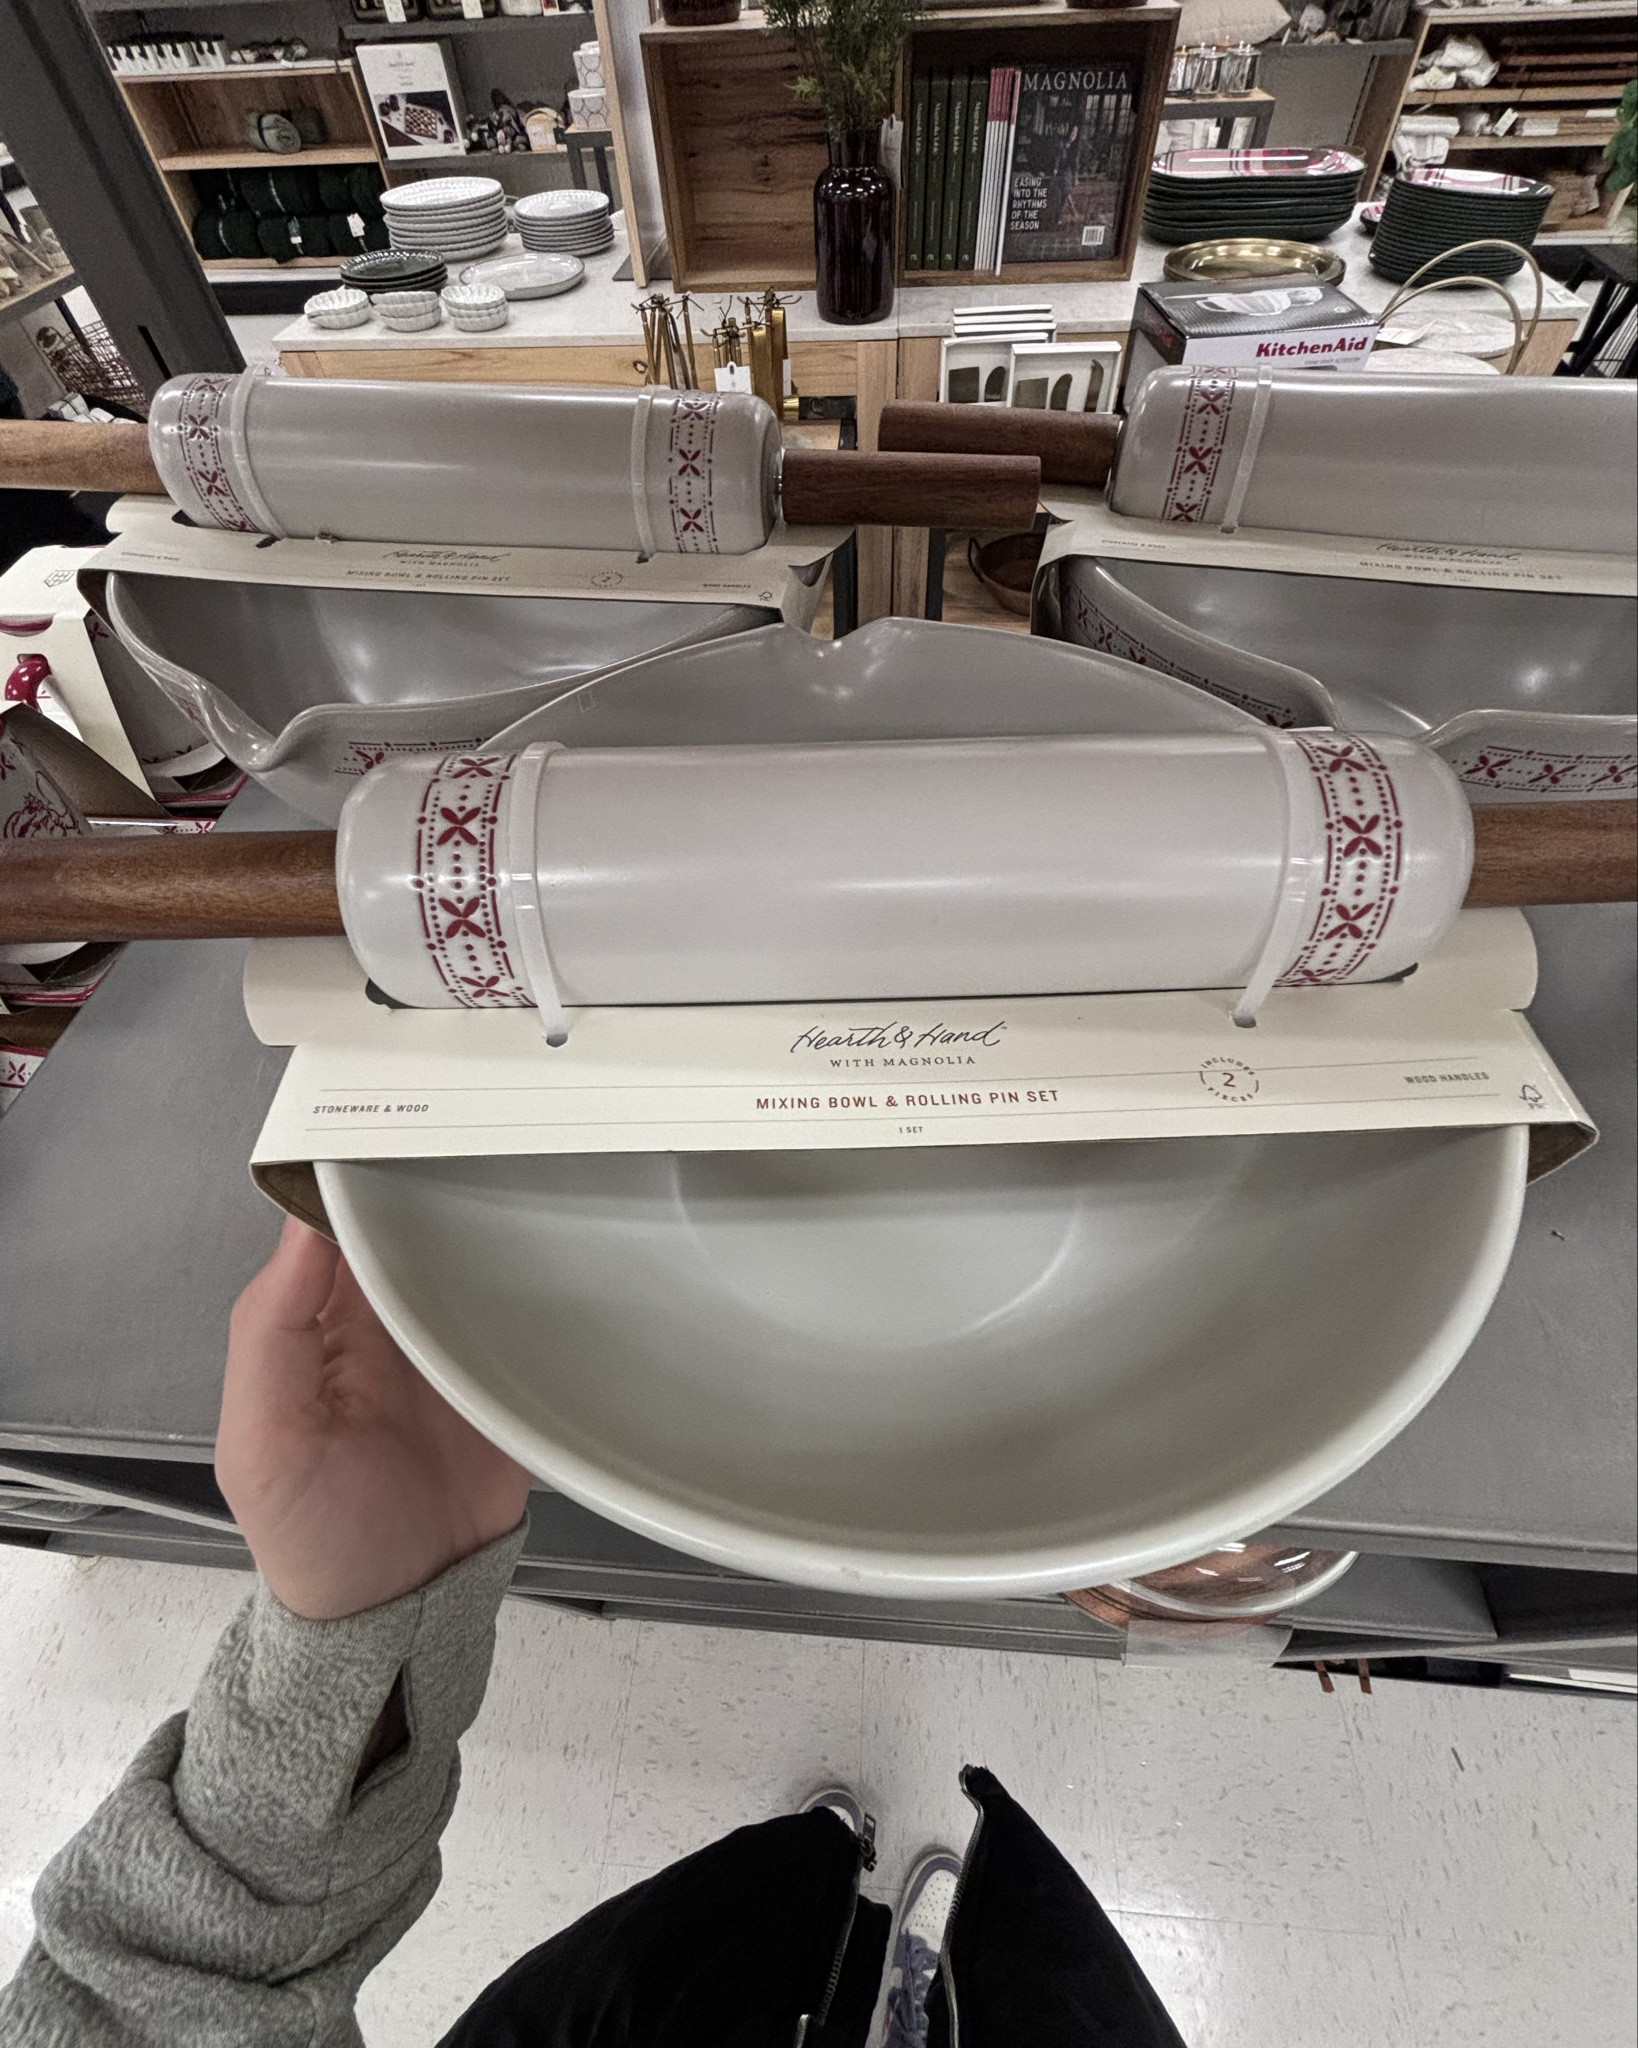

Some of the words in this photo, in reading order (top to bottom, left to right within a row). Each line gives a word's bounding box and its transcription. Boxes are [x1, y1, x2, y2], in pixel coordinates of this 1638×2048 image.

[1023, 71, 1127, 91] MAGNOLIA
[1014, 177, 1042, 187] EASING
[1013, 188, 1031, 198] INTO
[1033, 188, 1047, 198] THE
[1012, 199, 1047, 208] RHYTHMS
[1011, 210, 1022, 219] OF
[1024, 210, 1038, 219] THE
[1010, 221, 1040, 230] SEASON
[1256, 337, 1368, 357] KitchenAid
[790, 1021, 898, 1053] Hearth
[894, 1025, 913, 1049] &
[914, 1021, 1005, 1048] Hand
[830, 1058, 875, 1068] WITH
[883, 1056, 976, 1067] MAGNOLIA
[1222, 1072, 1236, 1088] 2
[1404, 1075, 1437, 1084] WOOD
[1440, 1072, 1490, 1082] HANDLES
[756, 1097, 820, 1110] MIXING
[829, 1096, 878, 1108] BOWL
[886, 1095, 898, 1107] &
[906, 1093, 982, 1106] ROLLING
[990, 1091, 1019, 1103] PIN
[1027, 1090, 1059, 1102] SET
[313, 1104, 381, 1114] STONEWARE
[384, 1104, 392, 1113] &
[396, 1104, 429, 1113] WOOD
[906, 1126, 924, 1134] SET
